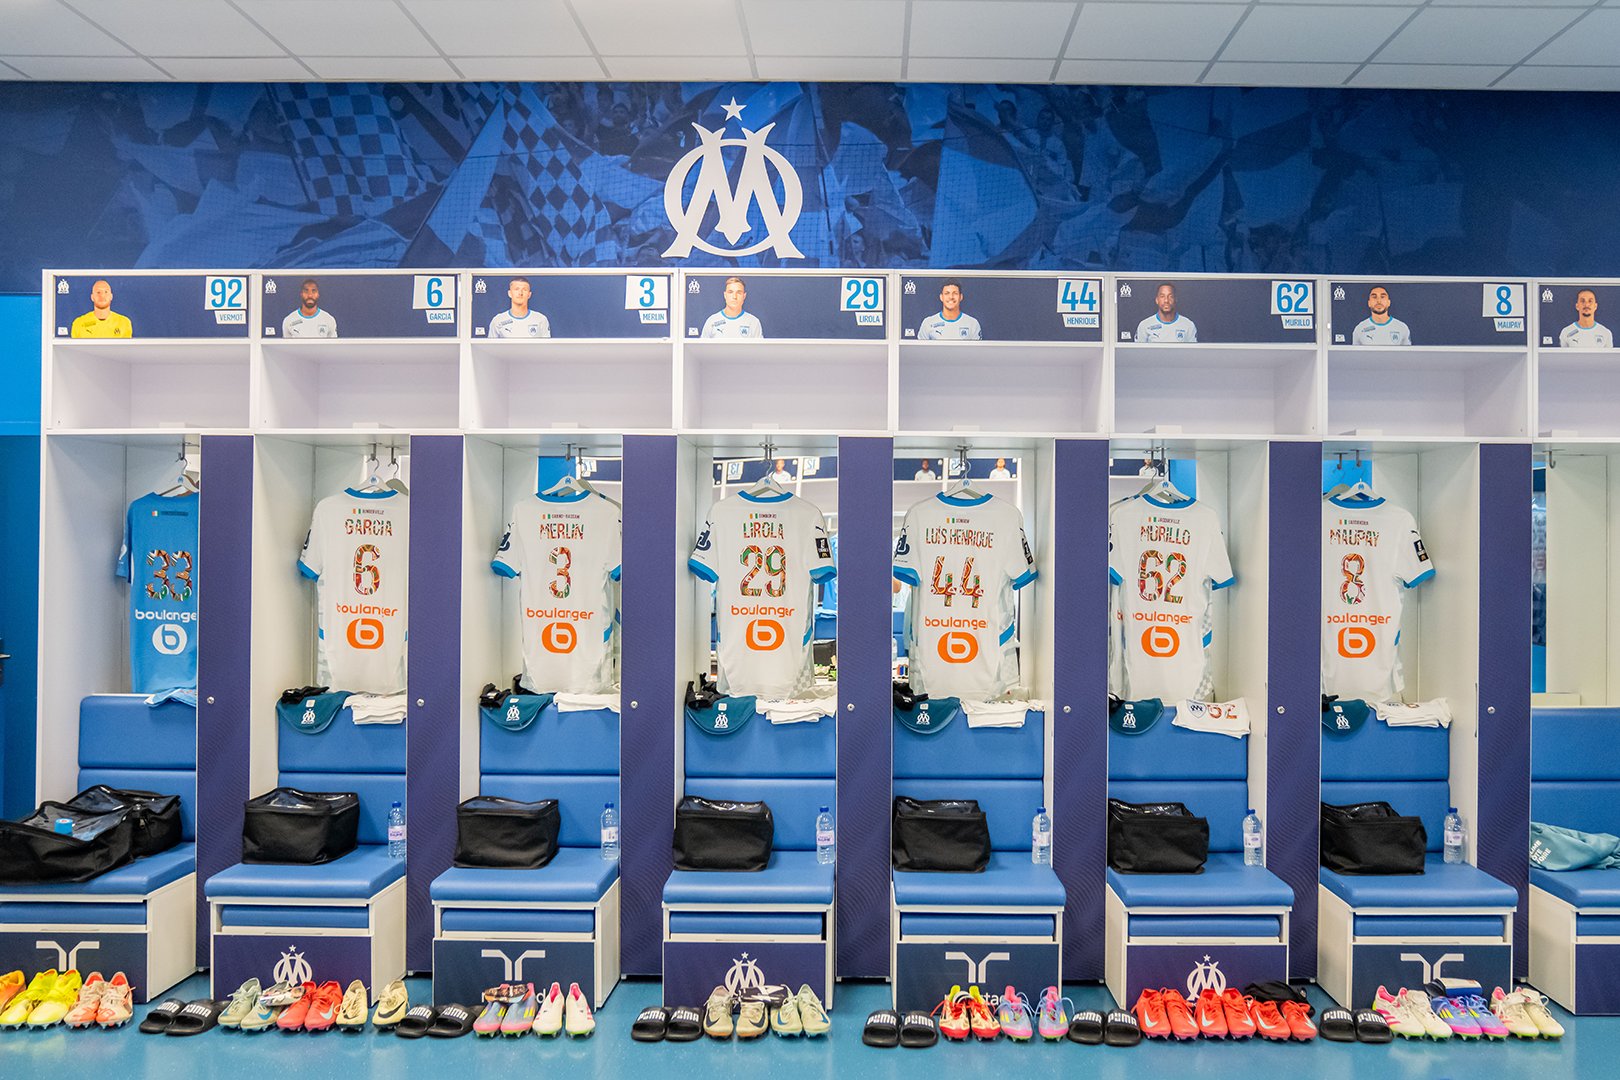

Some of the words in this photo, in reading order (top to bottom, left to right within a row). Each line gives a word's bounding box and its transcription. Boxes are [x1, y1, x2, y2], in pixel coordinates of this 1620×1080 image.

[210, 278, 242, 308] 92
[426, 277, 443, 308] 6
[639, 277, 655, 308] 3
[845, 279, 879, 309] 29
[1061, 281, 1097, 311] 44
[1276, 282, 1309, 313] 62
[1495, 285, 1512, 316] 8
[219, 313, 244, 322] VERMOT
[429, 312, 452, 321] GARCIA
[642, 312, 665, 321] MERLIN
[859, 315, 881, 323] LIROLA
[1066, 317, 1097, 325] HENRIQUE
[1284, 318, 1311, 327] MURILLO
[1497, 320, 1522, 329] MAUPAY
[344, 518, 393, 536] GARCIA
[539, 523, 585, 540] MERLIN
[743, 521, 785, 539] LIROLA
[1140, 525, 1191, 545] MURILLO
[949, 528, 994, 549] HENRIQUE
[1329, 529, 1380, 547] MAUPAY
[145, 549, 193, 602] 33
[353, 544, 381, 596] 6
[549, 546, 572, 599] 3
[739, 545, 787, 598] 29
[1138, 549, 1188, 604] 62
[931, 555, 984, 609] 44
[1340, 553, 1366, 605] 8
[134, 608, 198, 623] boulange
[336, 602, 399, 618] oulaner
[527, 607, 595, 622] boulanger
[924, 615, 990, 631] boulange
[637, 1010, 666, 1021] PUMA
[670, 1010, 700, 1022] PUMA
[866, 1013, 897, 1026] PUMA
[904, 1014, 934, 1028] PUMA
[1072, 1011, 1102, 1024] PUMA
[1107, 1012, 1137, 1026] PUMA
[1323, 1010, 1353, 1022] PUMA
[1357, 1012, 1388, 1025] PUMA
